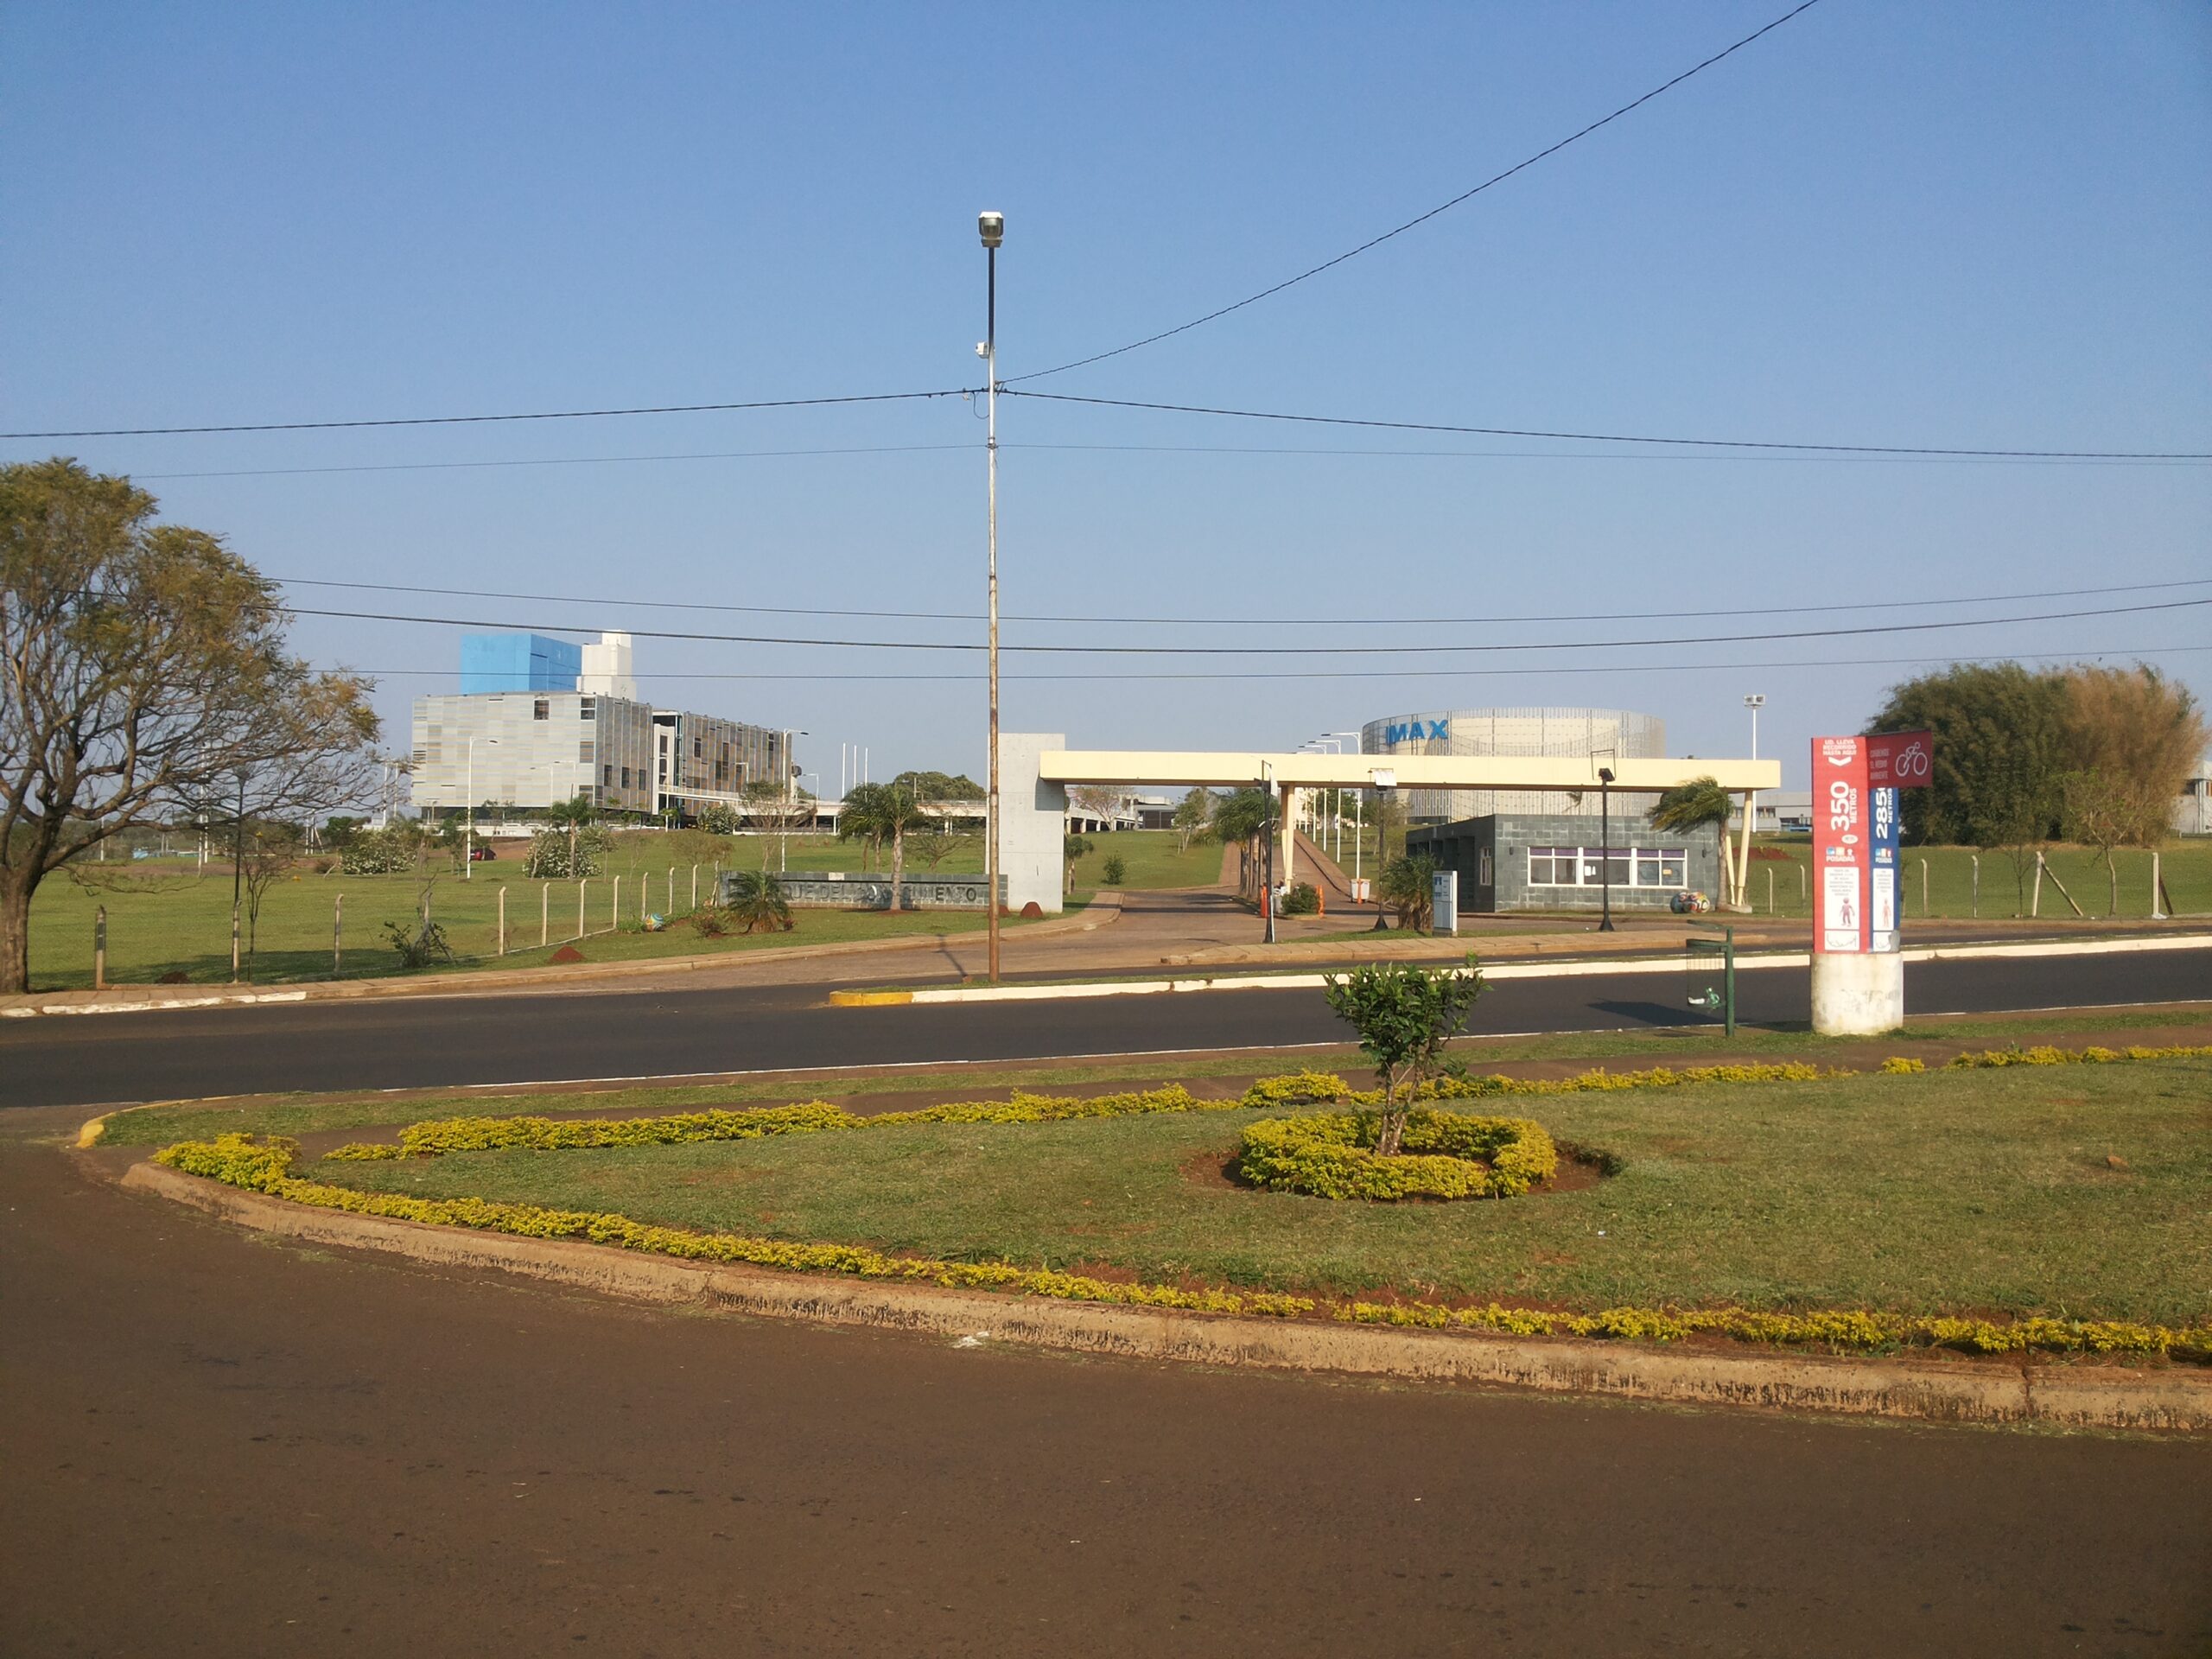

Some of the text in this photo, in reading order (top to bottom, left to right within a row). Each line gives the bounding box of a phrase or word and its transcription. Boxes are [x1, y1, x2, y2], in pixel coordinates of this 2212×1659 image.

[1385, 719, 1449, 747] IMAX
[1830, 781, 1850, 832] 350
[1849, 787, 1858, 823] METROS
[1876, 787, 1888, 839] 285
